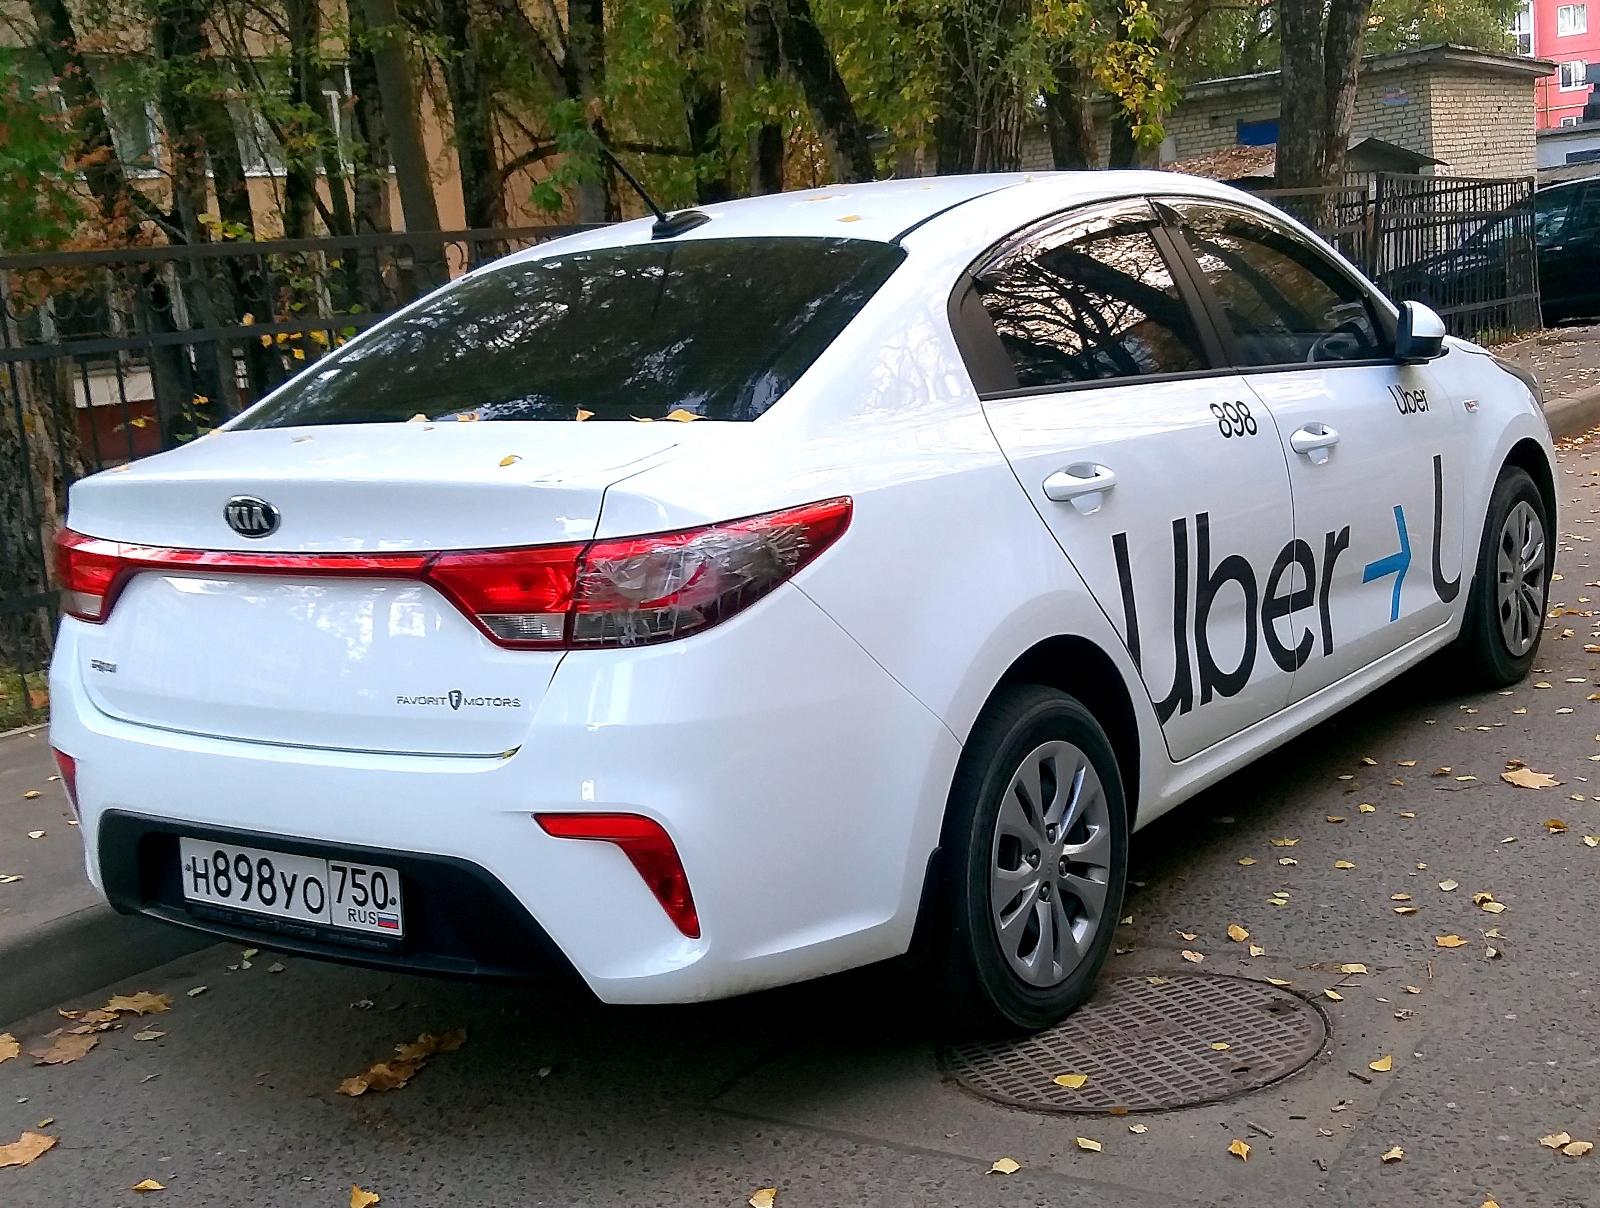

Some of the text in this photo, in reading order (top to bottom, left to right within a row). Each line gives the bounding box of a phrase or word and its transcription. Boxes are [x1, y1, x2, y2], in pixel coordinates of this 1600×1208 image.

[1389, 384, 1430, 416] Uber
[1209, 400, 1258, 439] 898
[225, 505, 271, 531] KIA
[1112, 511, 1350, 726] Uber
[396, 695, 448, 706] FAVORIT
[463, 696, 522, 708] MOTORS
[331, 864, 389, 910] 750
[348, 907, 377, 925] RUS
